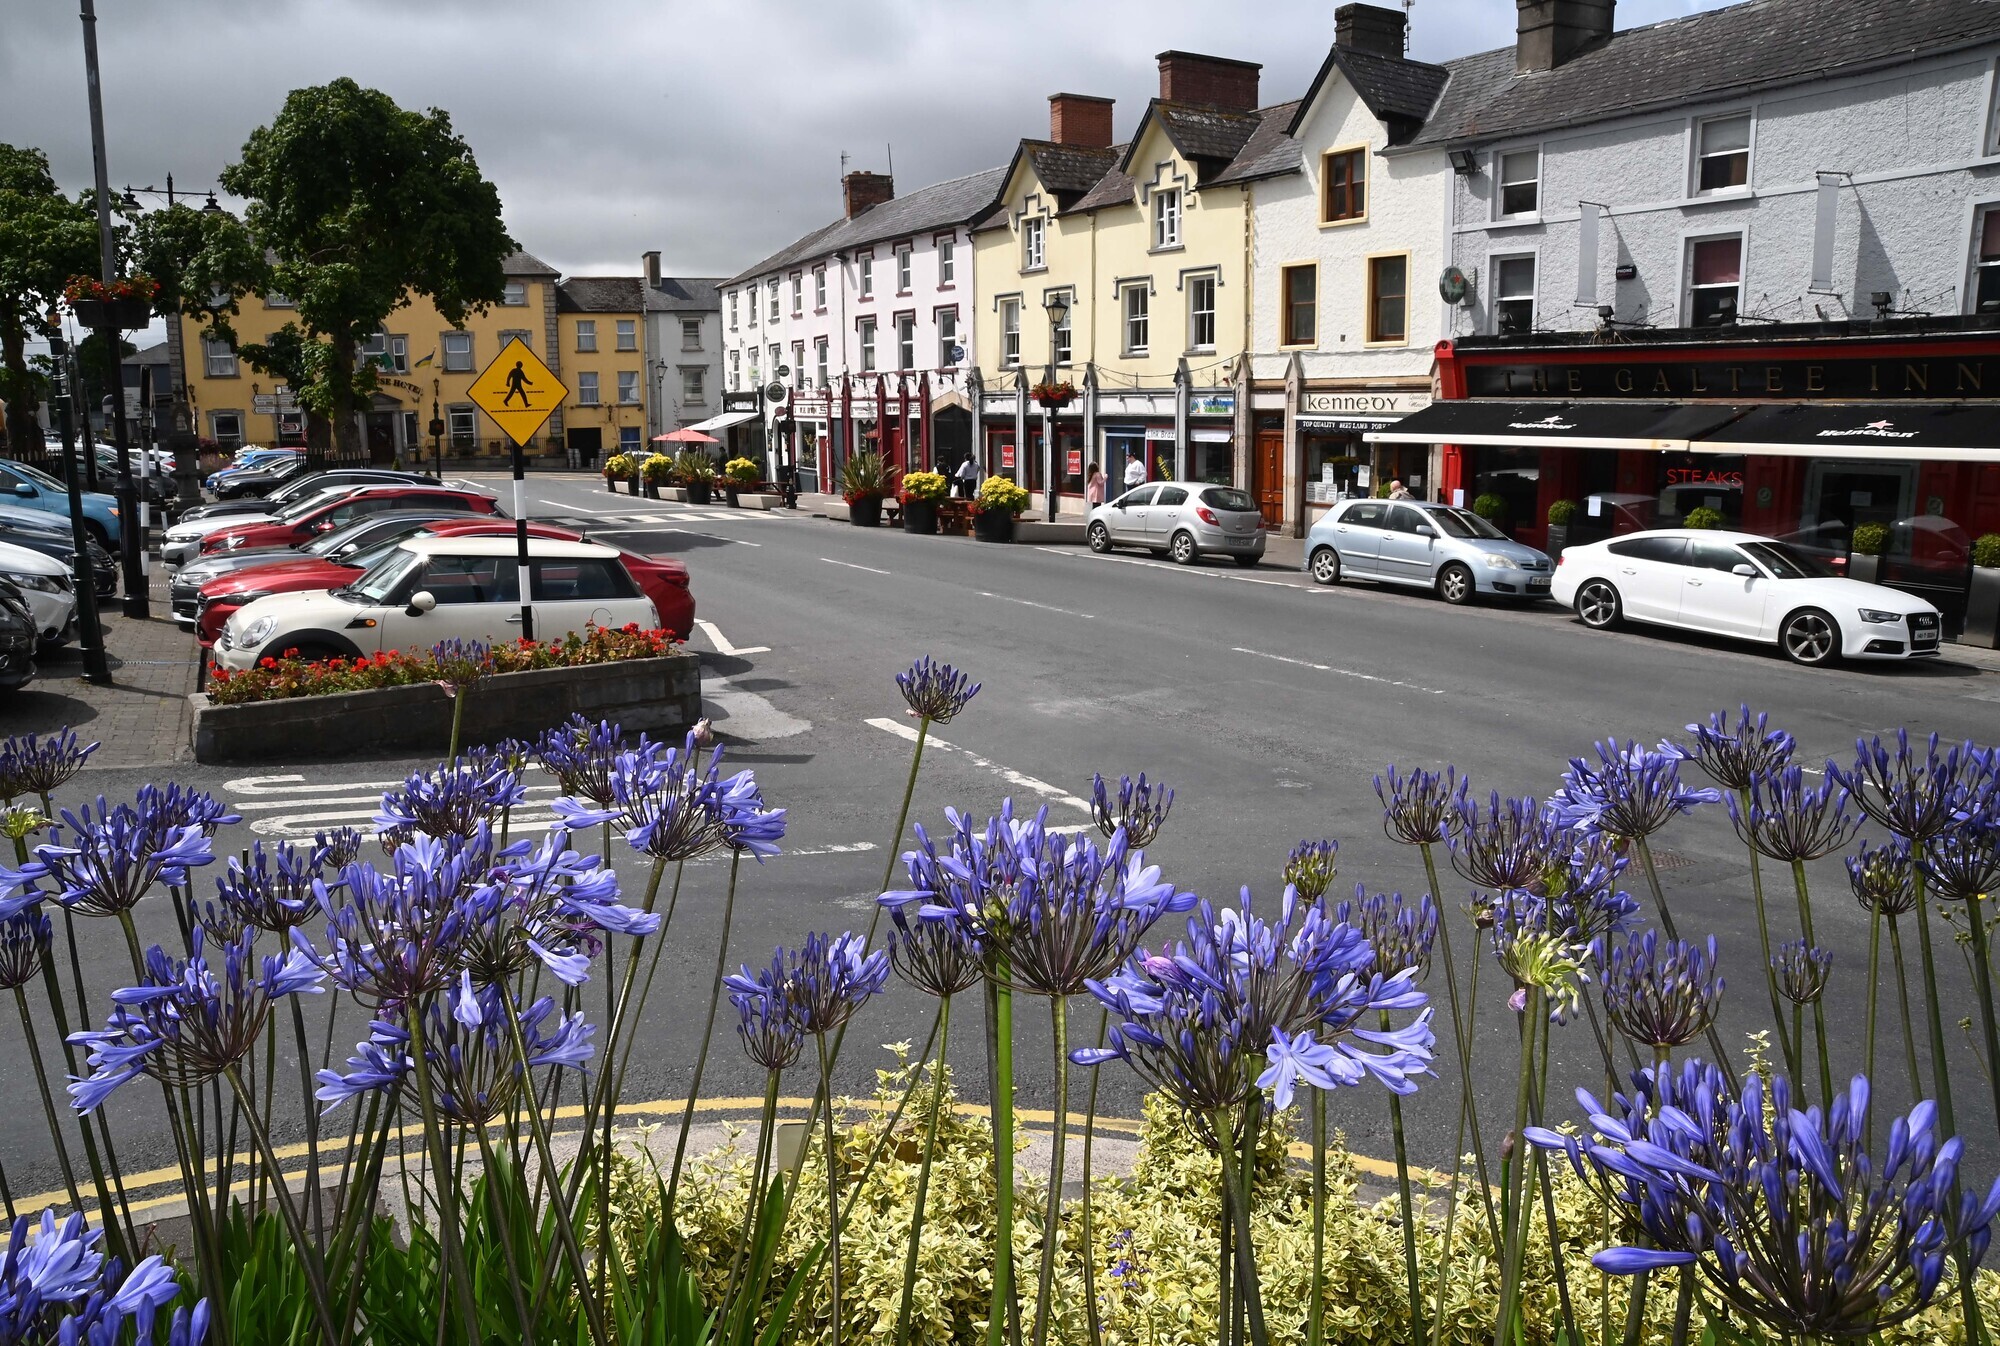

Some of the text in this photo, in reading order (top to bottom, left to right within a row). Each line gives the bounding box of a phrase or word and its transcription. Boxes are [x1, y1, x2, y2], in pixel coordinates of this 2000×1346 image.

[1500, 362, 1984, 393] THE GALTEE INN
[1313, 421, 1336, 429] QUALITY
[1816, 428, 1916, 438] Heineken
[1666, 468, 1744, 487] STEAKS
